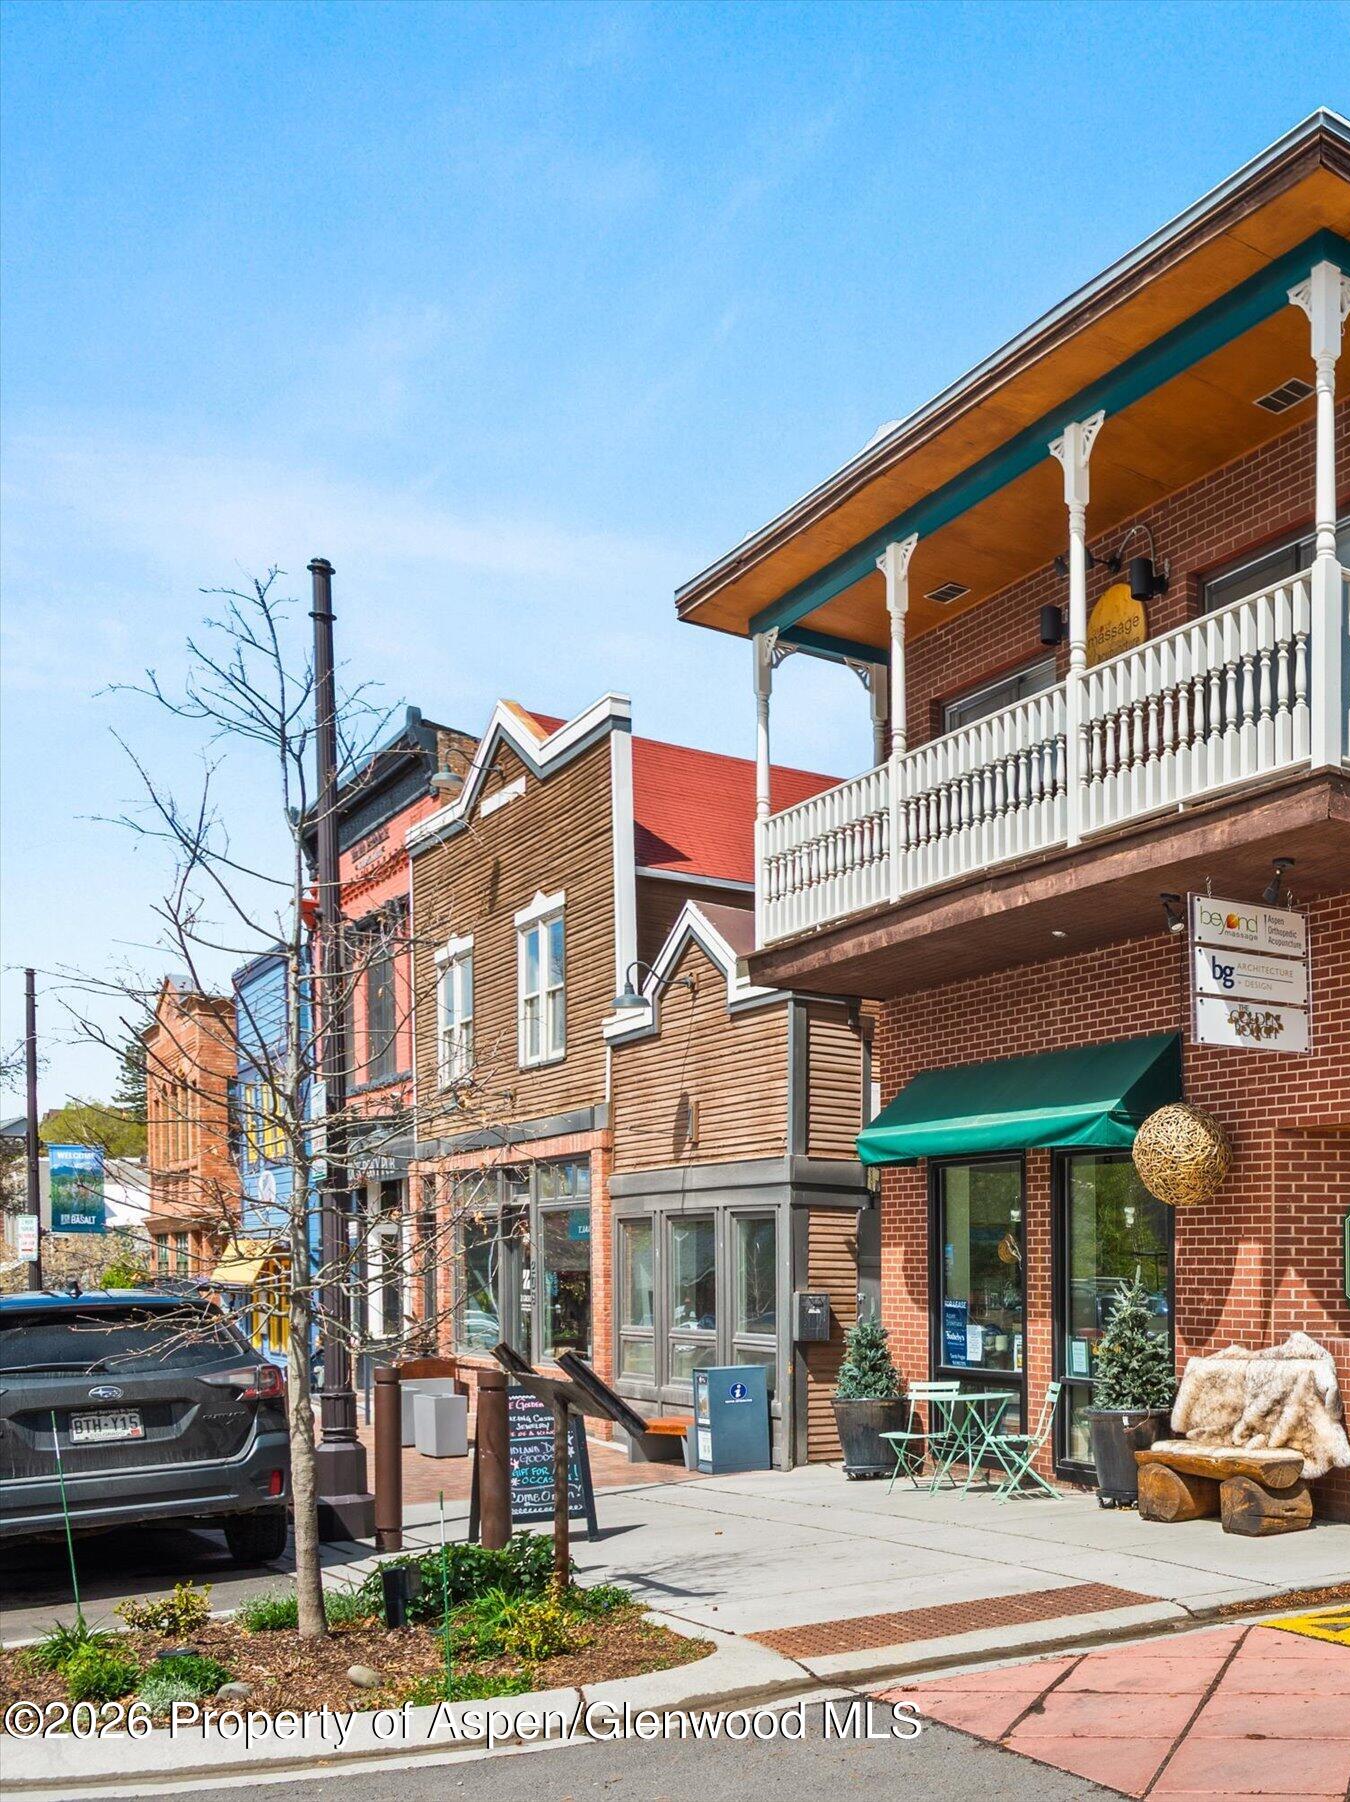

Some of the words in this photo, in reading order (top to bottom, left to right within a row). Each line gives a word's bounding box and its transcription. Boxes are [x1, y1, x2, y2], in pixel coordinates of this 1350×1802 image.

[1088, 615, 1140, 646] massage
[1200, 905, 1258, 935] beyond
[1268, 914, 1285, 927] Aspen
[1224, 930, 1258, 941] massage
[1268, 926, 1297, 939] Orthopedic
[1211, 955, 1235, 989] bg
[1237, 962, 1294, 978] ARCHITECTURE
[1244, 979, 1273, 991] DESIGN
[71, 1215, 97, 1225] BASALT
